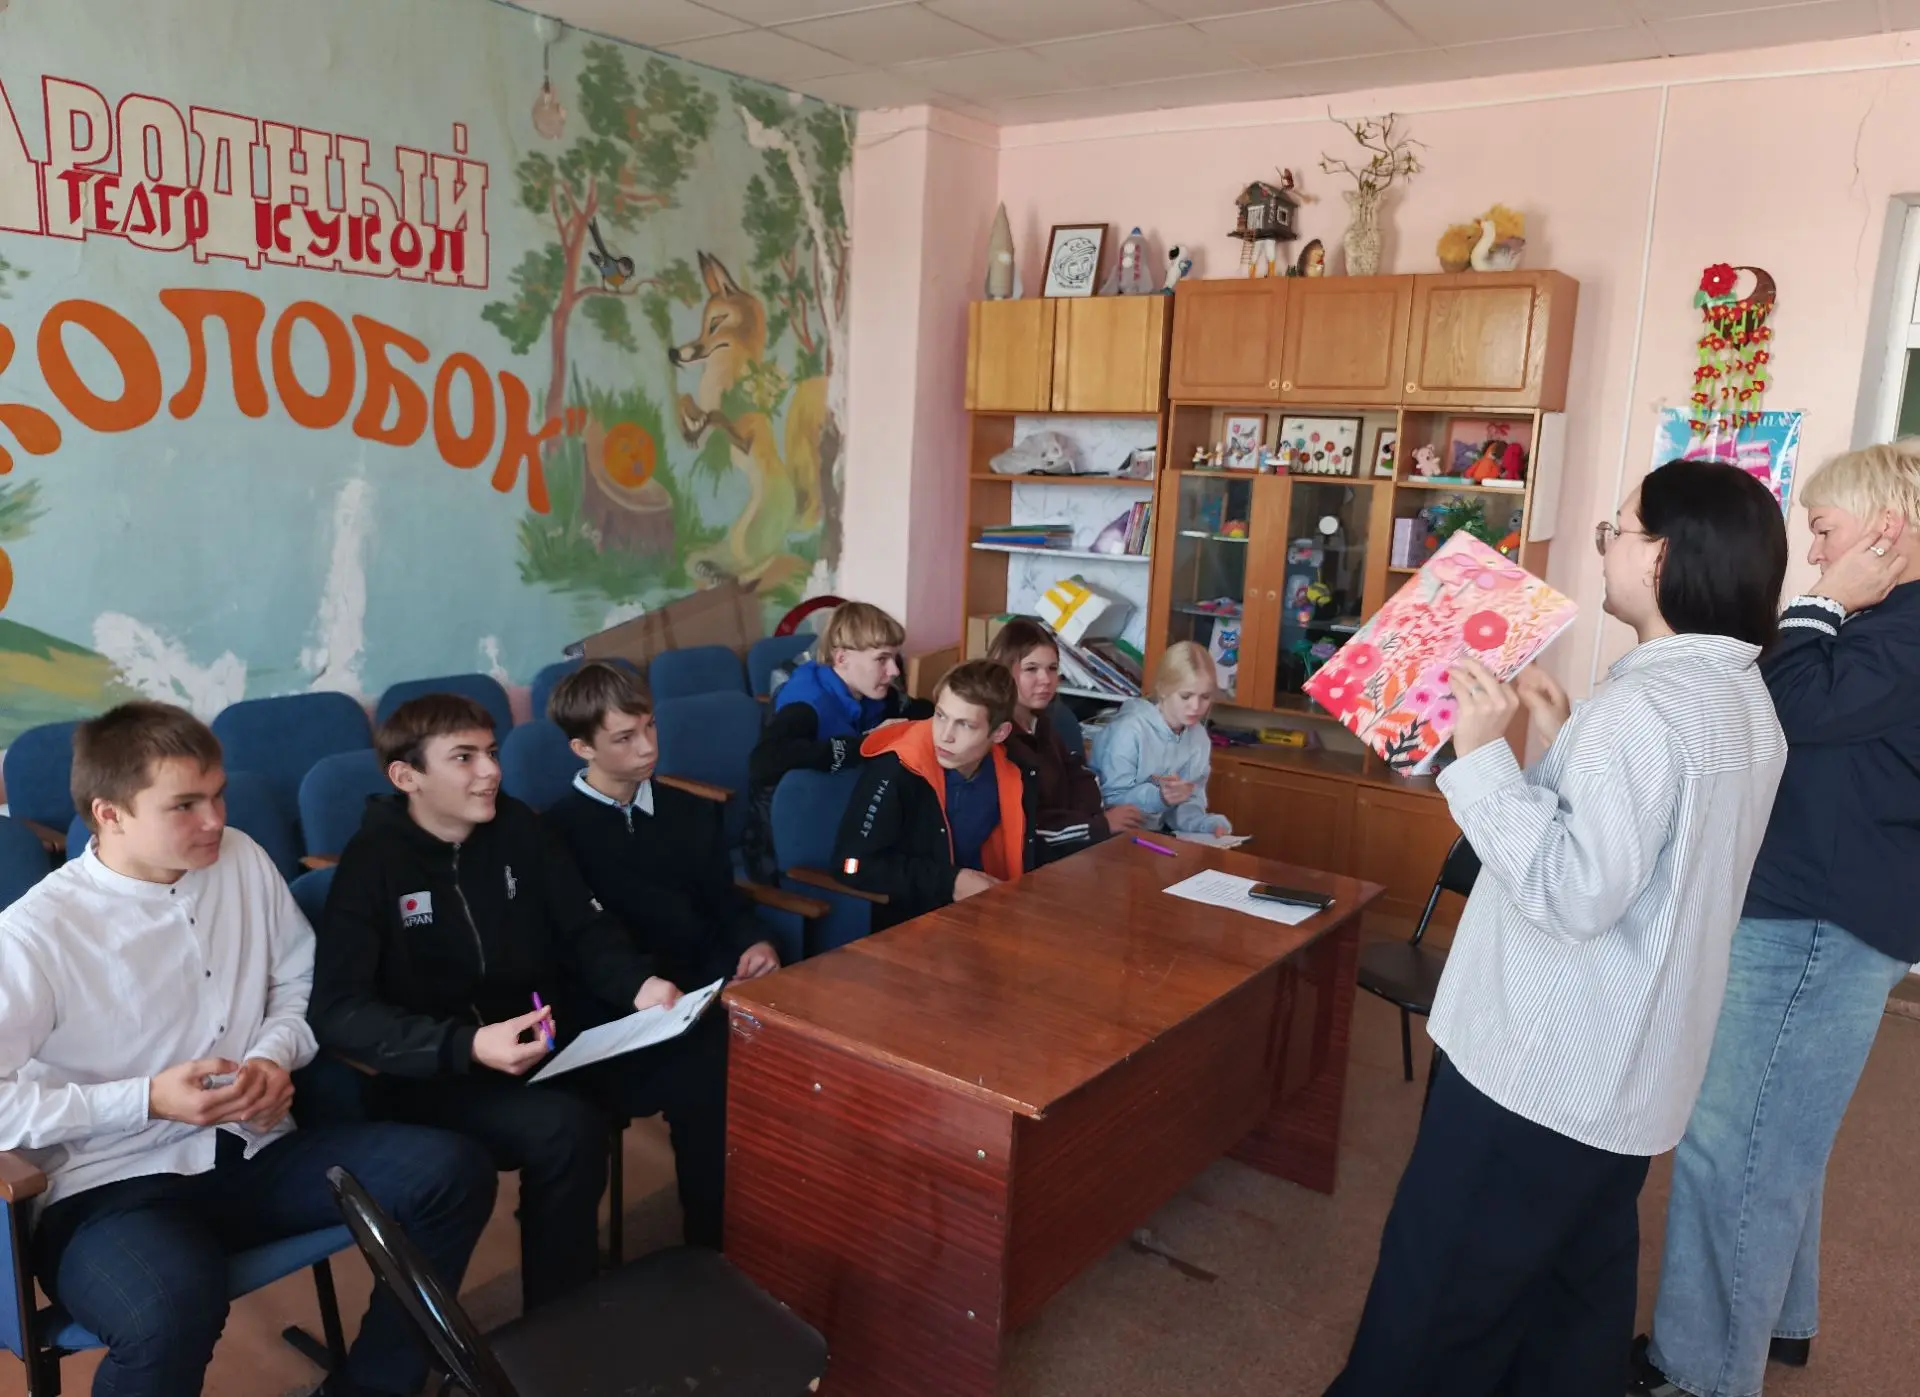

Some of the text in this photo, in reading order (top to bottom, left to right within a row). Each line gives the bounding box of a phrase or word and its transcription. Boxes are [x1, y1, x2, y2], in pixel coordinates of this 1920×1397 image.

[57, 169, 466, 275] ТЕАТР КУКОЛ
[860, 804, 878, 838] BEST
[403, 912, 433, 929] APAN
